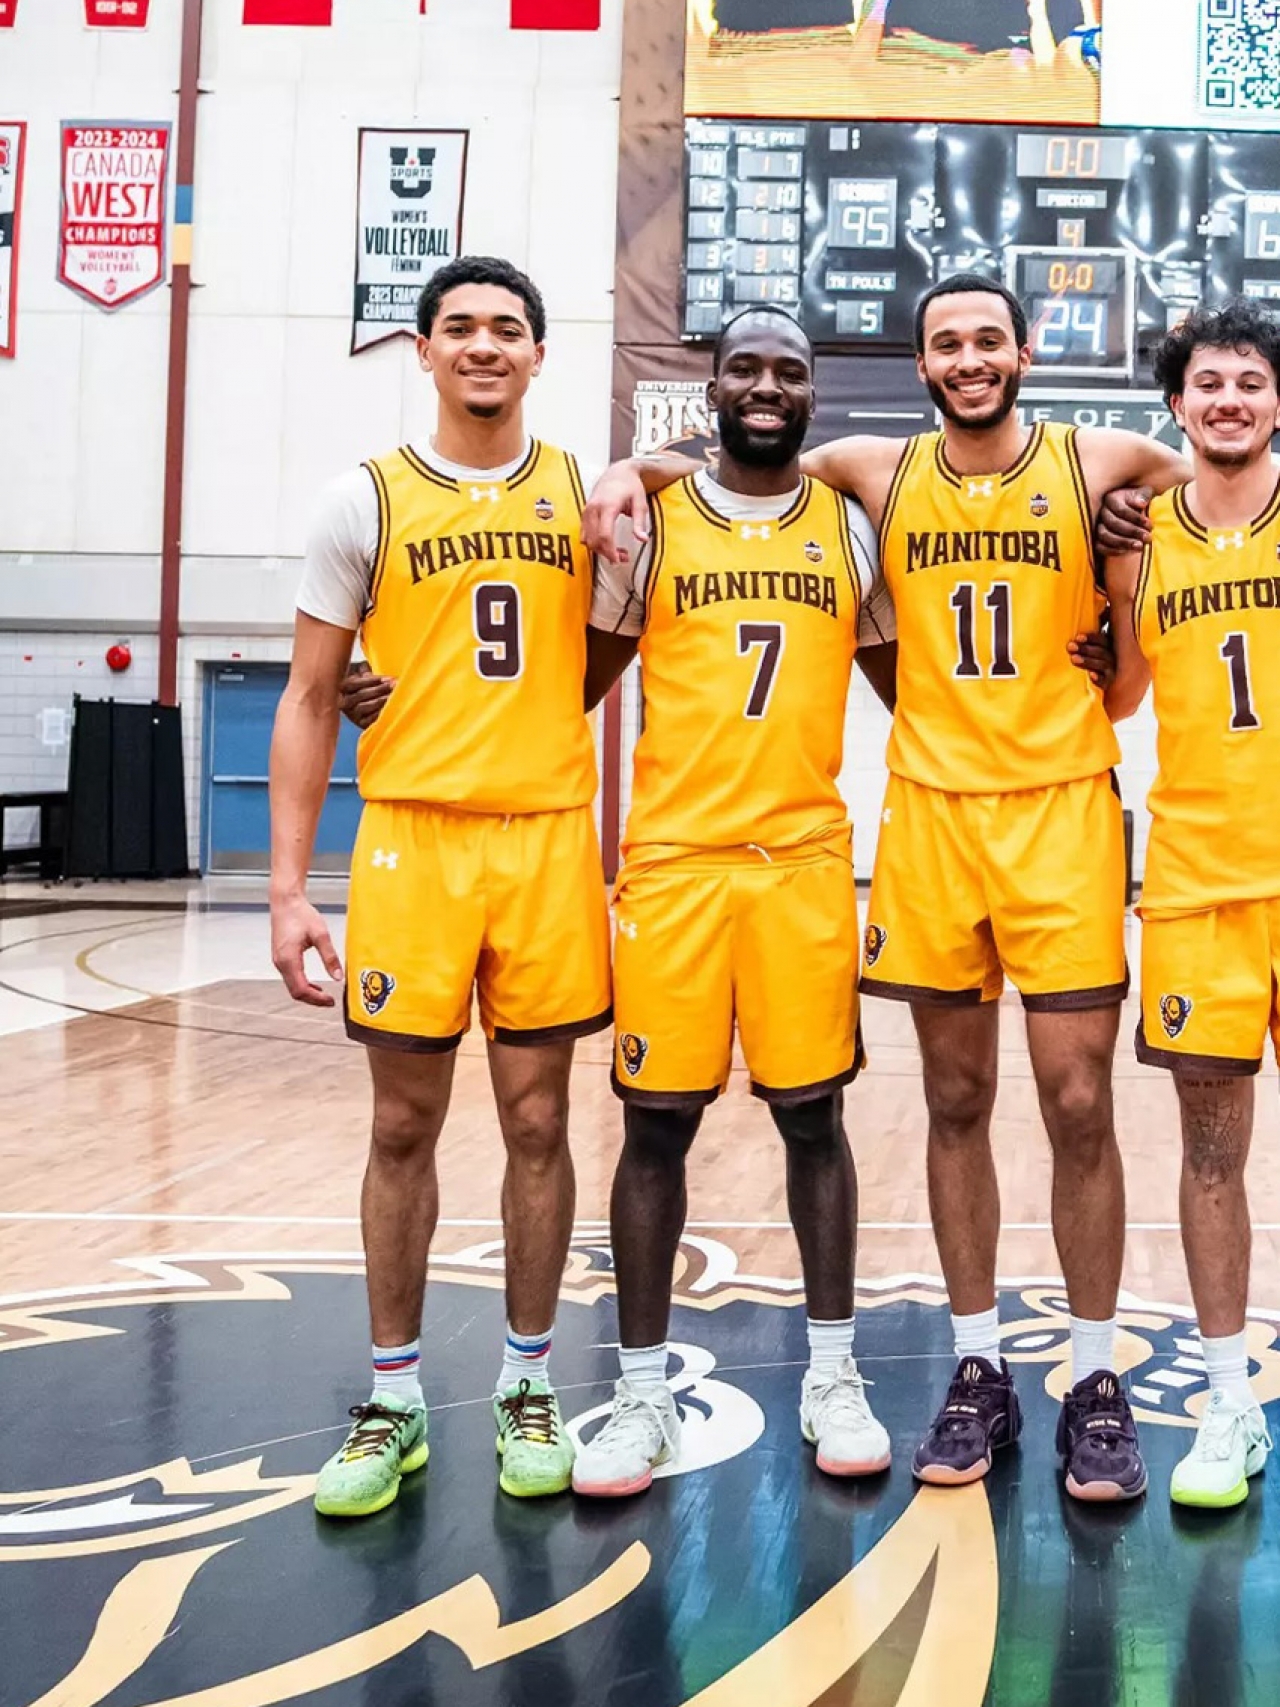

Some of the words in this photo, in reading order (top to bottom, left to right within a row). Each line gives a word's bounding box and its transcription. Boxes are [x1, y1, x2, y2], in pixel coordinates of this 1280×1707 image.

[73, 130, 158, 147] 2023-2024
[72, 151, 158, 177] CANADA
[785, 154, 799, 174] 7
[1046, 138, 1100, 178] 0.0
[391, 168, 433, 178] SPORTS
[72, 181, 155, 218] WEST
[701, 185, 721, 205] 12
[65, 226, 156, 242] CHAMPIONS
[707, 214, 721, 234] 4
[782, 216, 796, 237] 6
[842, 206, 890, 246] 95
[1061, 222, 1081, 247] 4
[364, 226, 450, 257] VOLLEYBALL
[706, 245, 721, 268] 3
[782, 247, 796, 268] 4
[699, 278, 720, 299] 14
[774, 279, 795, 301] 15
[859, 302, 878, 332] 5
[1036, 299, 1103, 353] 24
[1073, 410, 1125, 428] OF
[404, 530, 575, 586] MANITOBA
[906, 530, 1063, 574] MANITOBA
[673, 570, 838, 618] MANITOBA
[471, 581, 524, 681] 9
[949, 581, 1020, 679] 11
[736, 621, 785, 720] 7
[1217, 630, 1262, 733] 1
